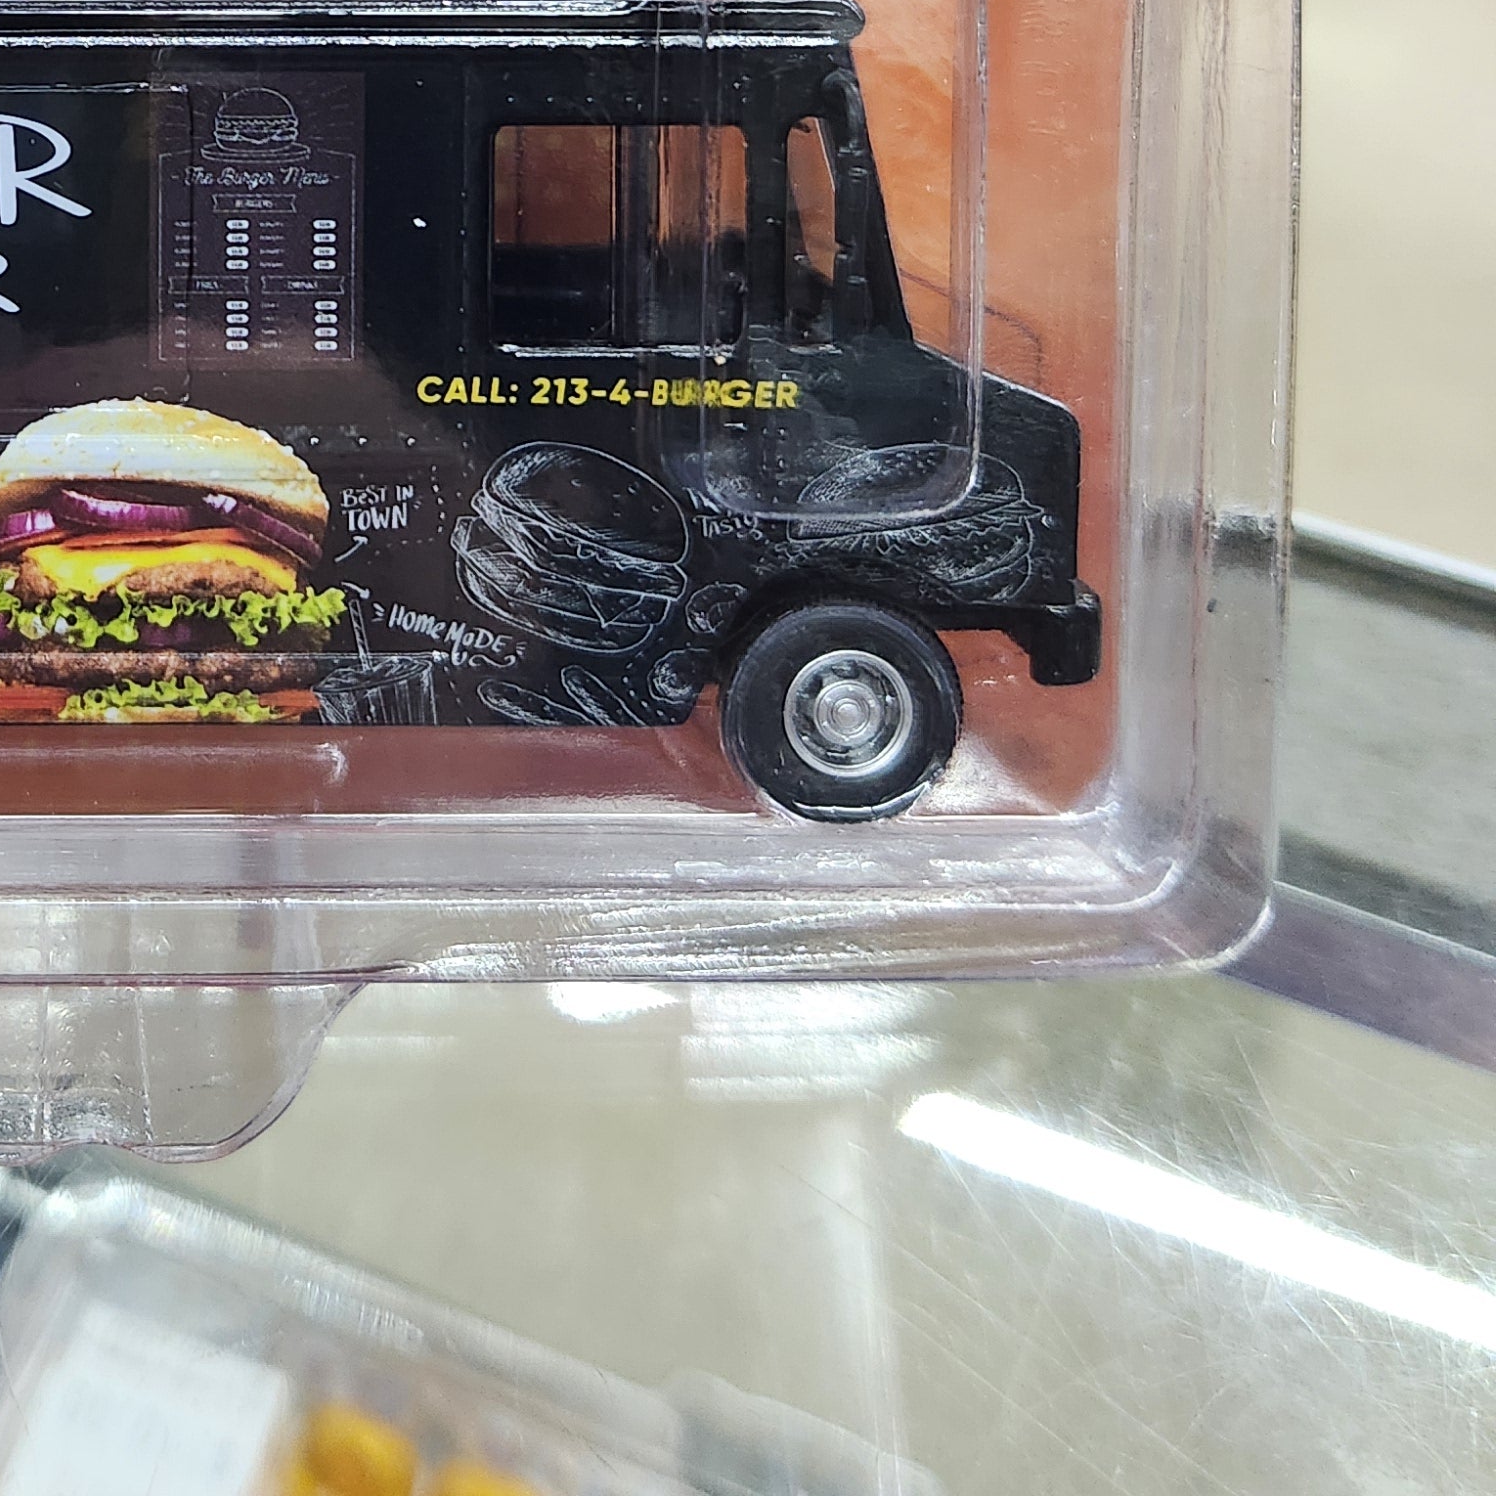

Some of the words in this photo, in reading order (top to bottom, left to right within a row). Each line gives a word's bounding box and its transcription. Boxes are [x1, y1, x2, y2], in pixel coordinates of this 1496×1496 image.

[416, 375, 519, 404] CALL:
[530, 377, 800, 409] 213-4-BURGER
[395, 484, 414, 501] IN
[342, 502, 408, 532] TOWN
